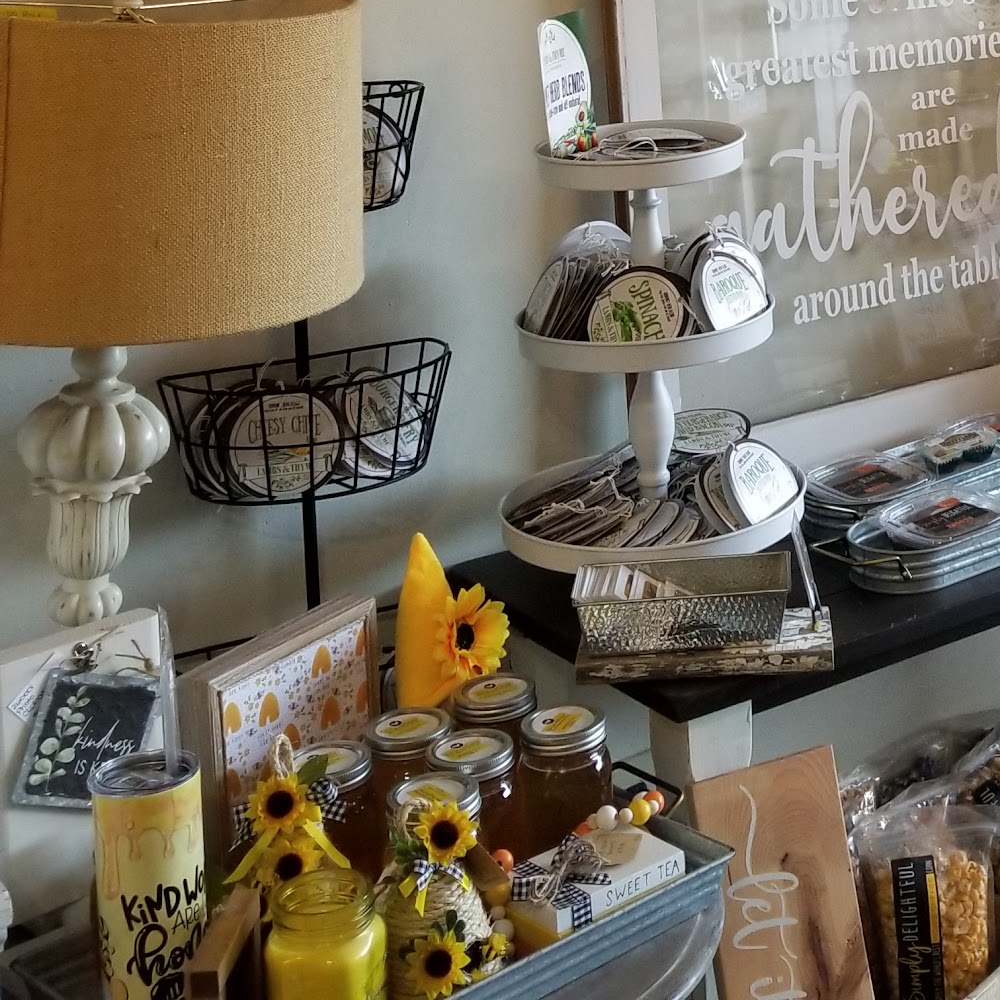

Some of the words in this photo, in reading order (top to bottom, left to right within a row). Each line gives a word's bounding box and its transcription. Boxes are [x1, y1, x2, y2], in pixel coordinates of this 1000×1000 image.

[561, 70, 586, 97] BLENDS
[725, 42, 860, 101] greatest
[911, 83, 957, 111] are
[896, 115, 974, 153] made
[628, 279, 666, 341] SPINACH
[792, 261, 897, 326] around
[900, 254, 946, 299] the
[247, 416, 287, 444] CHESY
[291, 413, 322, 436] CHIE
[291, 461, 312, 472] THYM
[73, 716, 136, 761] kindness
[74, 760, 86, 775] IS
[605, 871, 652, 907] SWEET
[656, 859, 681, 881] TEA
[897, 861, 919, 942] DELIGHTFUL
[899, 941, 933, 1000] Simply
